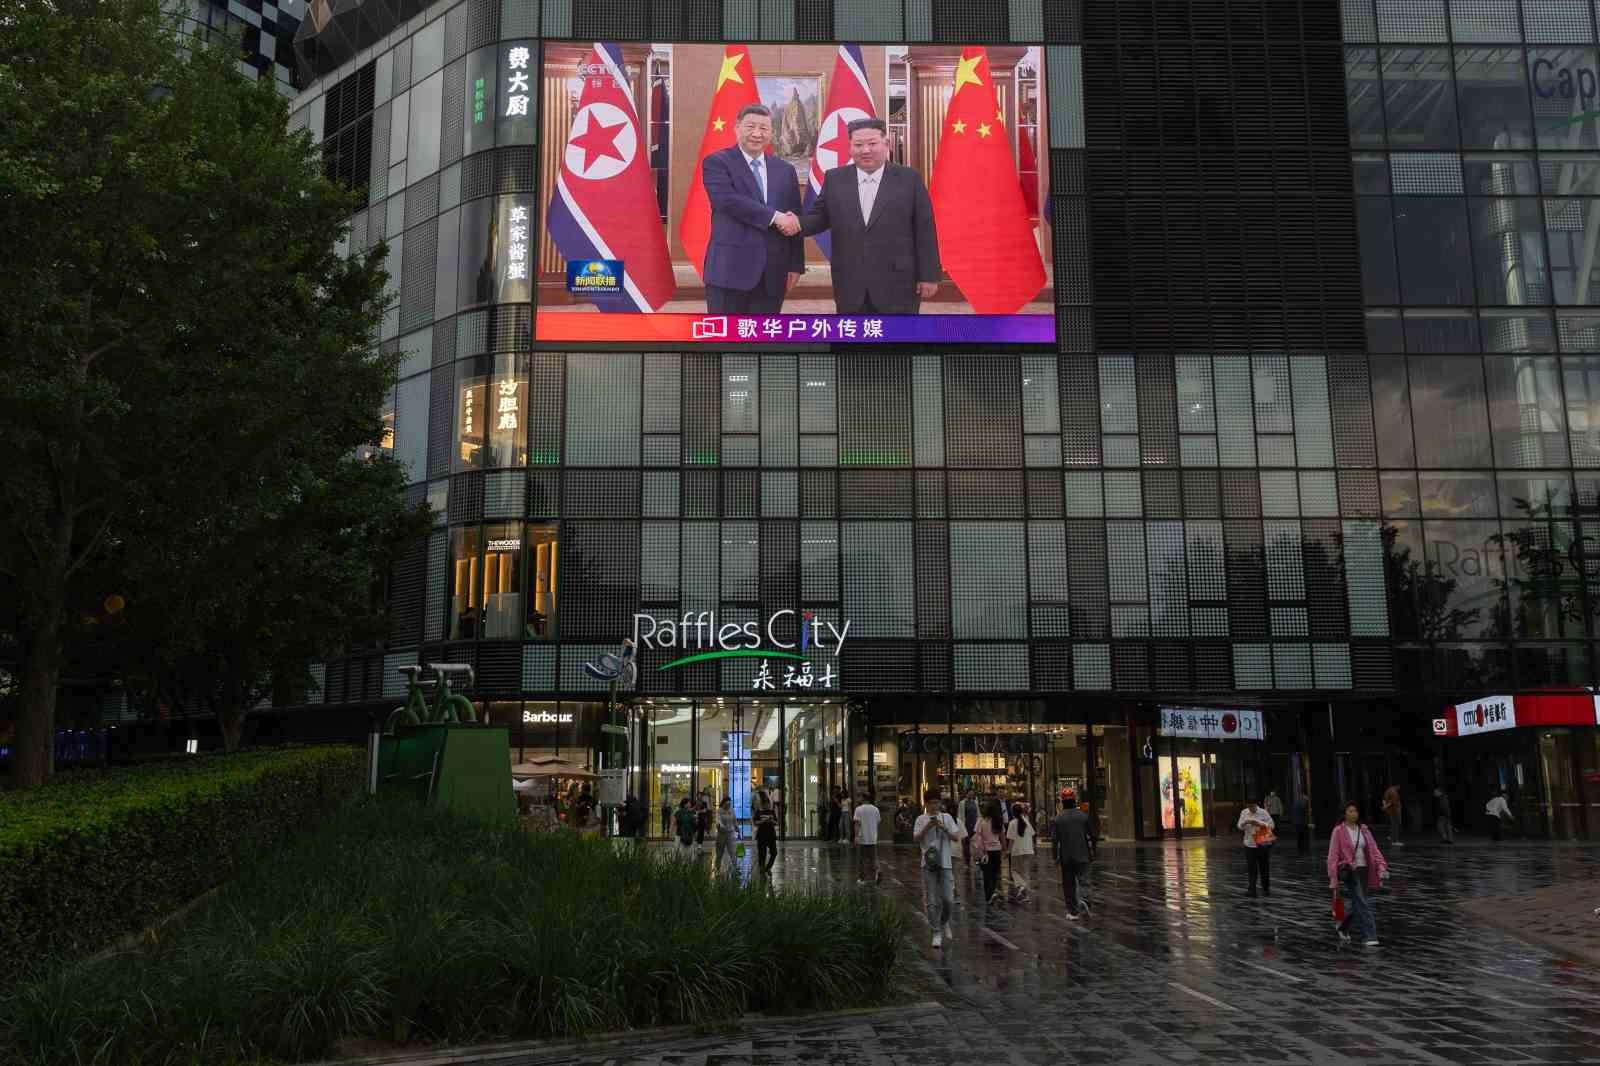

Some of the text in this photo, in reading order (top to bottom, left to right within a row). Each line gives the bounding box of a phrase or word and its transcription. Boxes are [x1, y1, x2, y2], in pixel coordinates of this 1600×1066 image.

[505, 46, 530, 117] 费大厨
[737, 318, 884, 339] 歌华户外传媒
[633, 608, 850, 656] Raffles City
[752, 658, 837, 690] 来福士
[522, 710, 573, 723] Barbour
